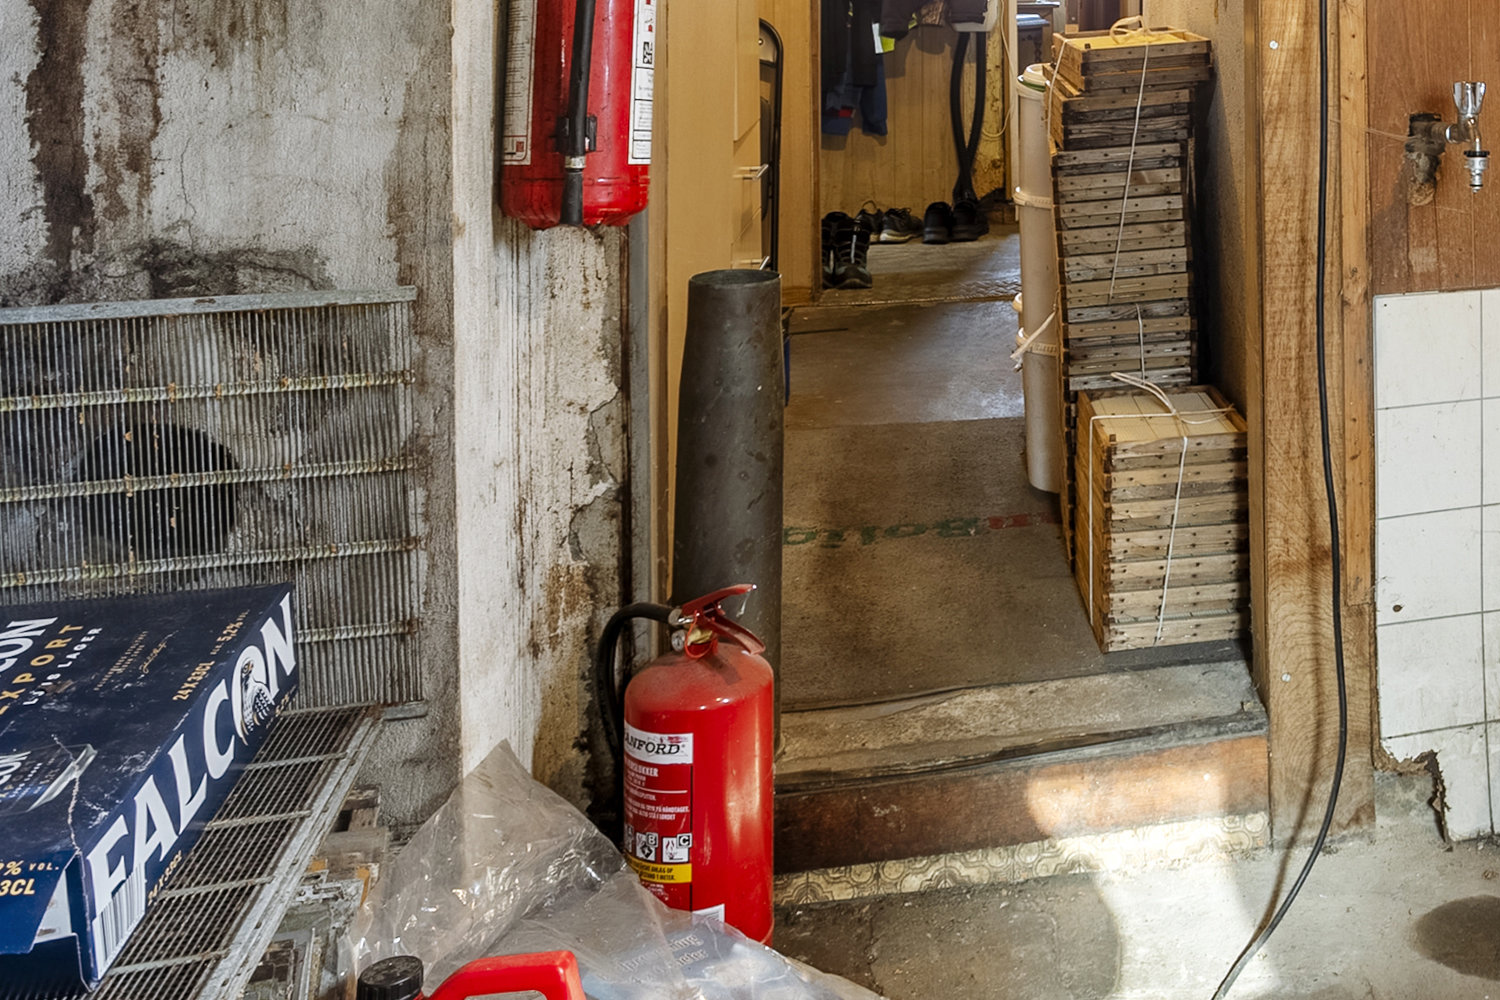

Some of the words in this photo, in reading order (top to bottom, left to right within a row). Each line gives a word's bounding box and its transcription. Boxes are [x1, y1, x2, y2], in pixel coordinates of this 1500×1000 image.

[57, 627, 103, 669] LAGER
[86, 591, 297, 915] FALCON
[679, 835, 690, 846] C
[29, 862, 60, 872] VOL.
